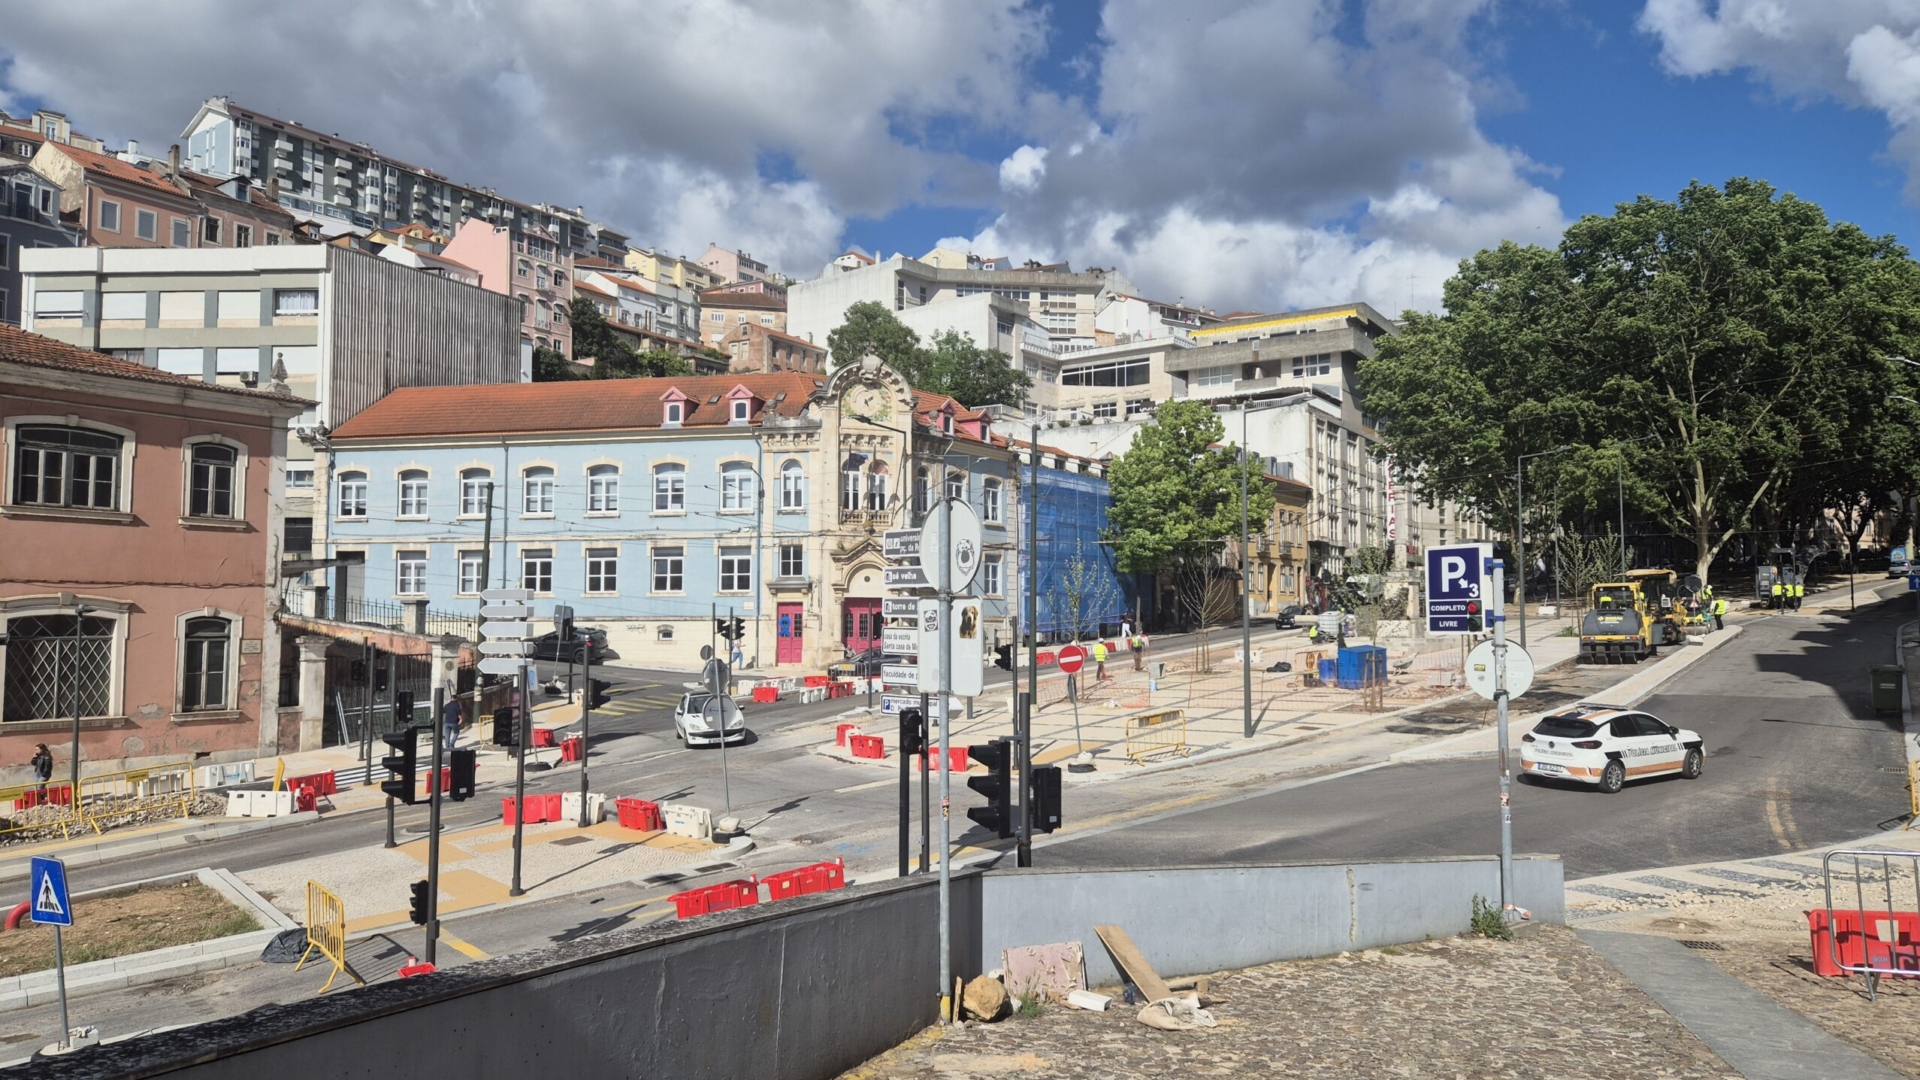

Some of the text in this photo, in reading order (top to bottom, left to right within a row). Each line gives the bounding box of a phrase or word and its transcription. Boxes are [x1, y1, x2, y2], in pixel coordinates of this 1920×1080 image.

[908, 543, 914, 551] da
[901, 571, 917, 580] velha
[1441, 556, 1466, 593] P
[1468, 583, 1479, 598] 3
[892, 602, 915, 611] torre de
[898, 633, 911, 641] escrita
[896, 643, 905, 651] casa
[906, 643, 911, 651] da
[883, 670, 907, 679] faculdade
[908, 671, 914, 679] de
